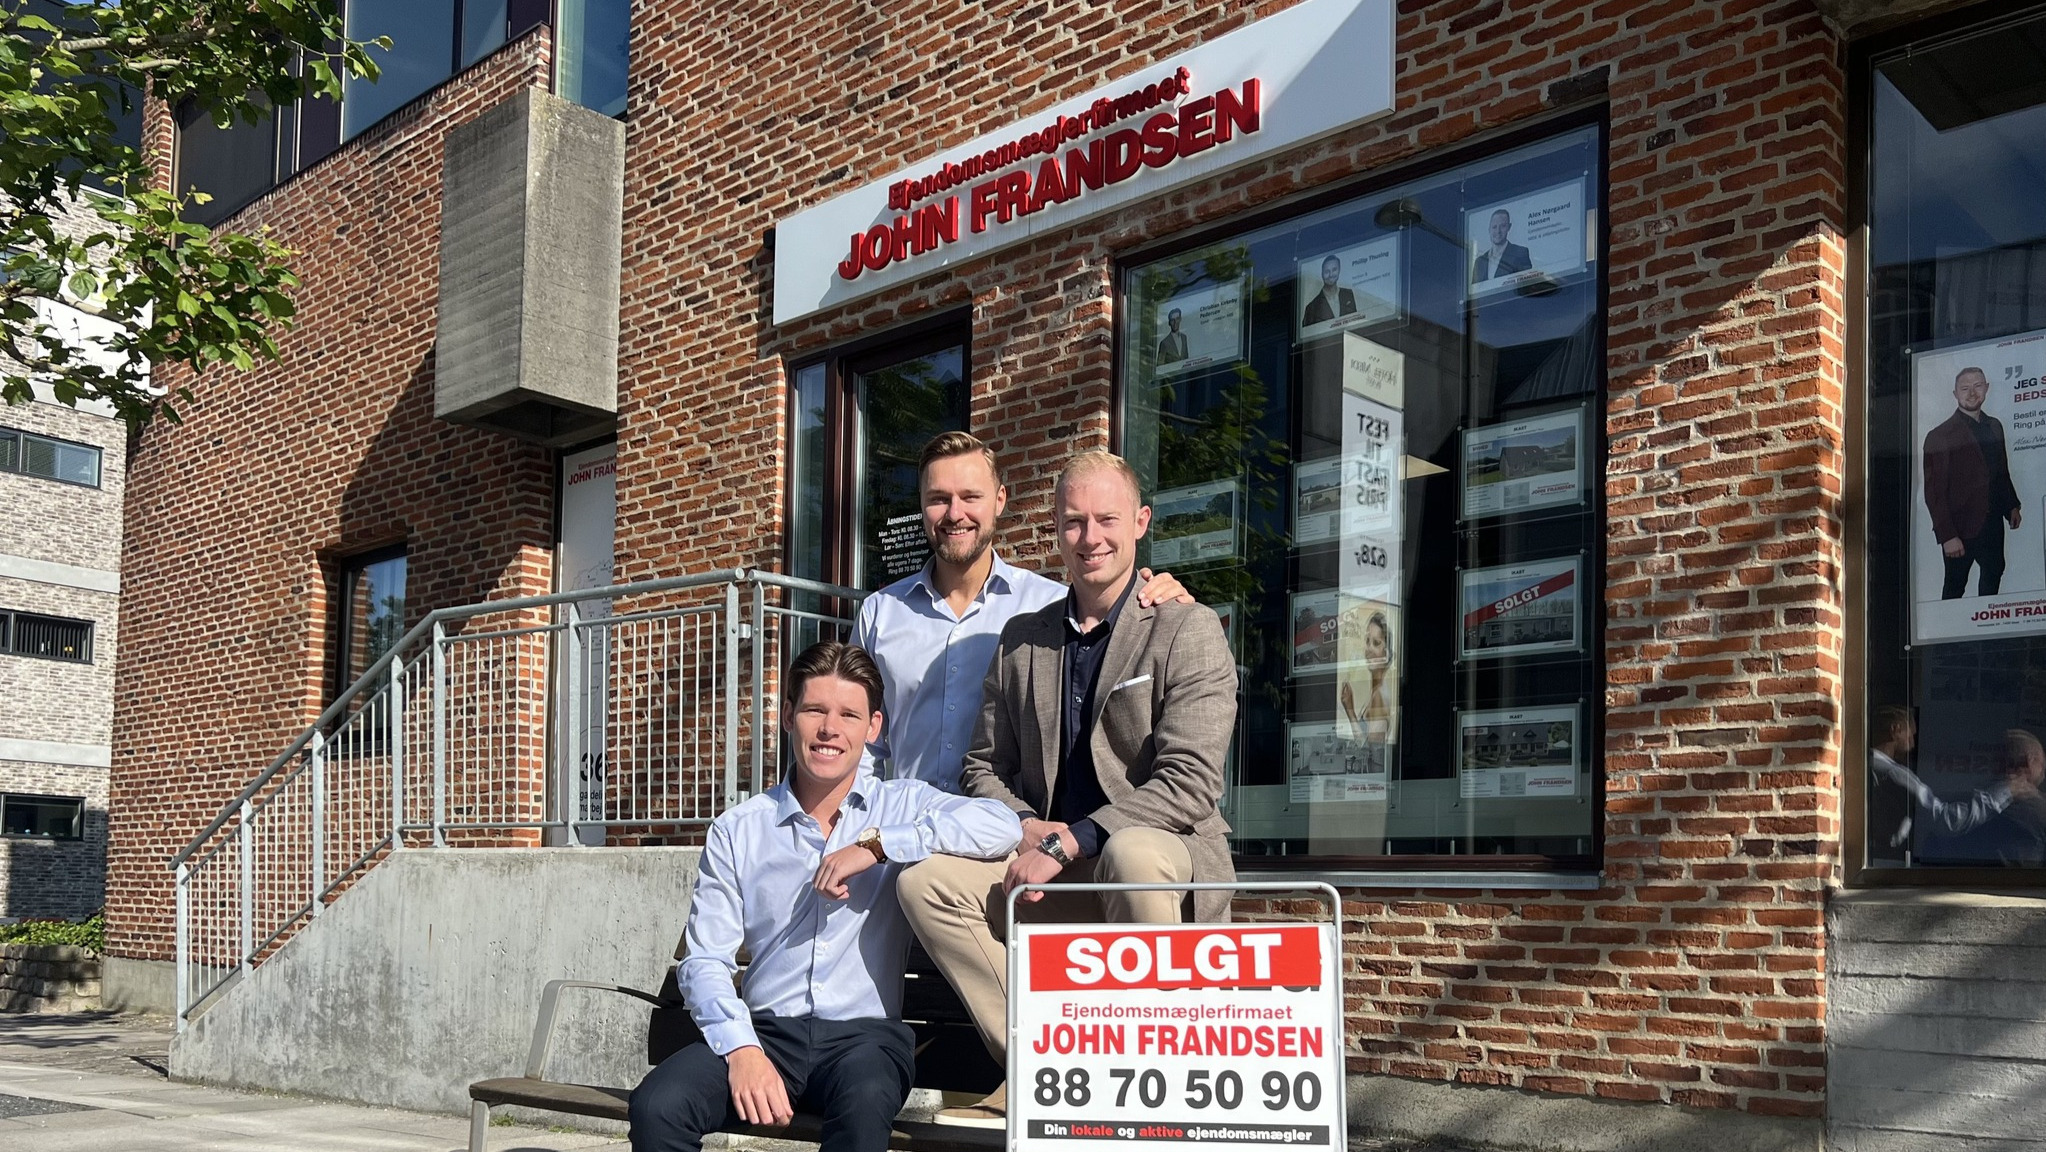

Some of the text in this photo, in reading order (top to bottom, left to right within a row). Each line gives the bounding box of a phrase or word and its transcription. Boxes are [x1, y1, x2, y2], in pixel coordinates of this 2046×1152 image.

[888, 66, 1191, 211] Ejendomsmæglerfirmaet
[838, 77, 1260, 280] JOHN FRANDSEN
[1527, 212, 1541, 220] Alex
[1527, 216, 1551, 227] Hansen
[2013, 377, 2038, 390] JEG
[2013, 410, 2036, 420] Bestil
[2013, 421, 2033, 430] Ring
[568, 469, 592, 486] JOHN
[1494, 585, 1541, 614] SOLGT
[1320, 607, 1360, 634] SOLGT
[1971, 605, 2046, 622] JOHN FRA
[1065, 933, 1282, 985] SOLGT
[1061, 1003, 1293, 1022] Ejendomsmæglerfirmaet
[1032, 1023, 1323, 1058] JOHN FRANDSEN
[1034, 1067, 1322, 1111] 88 70 50 90
[1044, 1123, 1313, 1143] Din lokale og aktive ejendomsmægler
